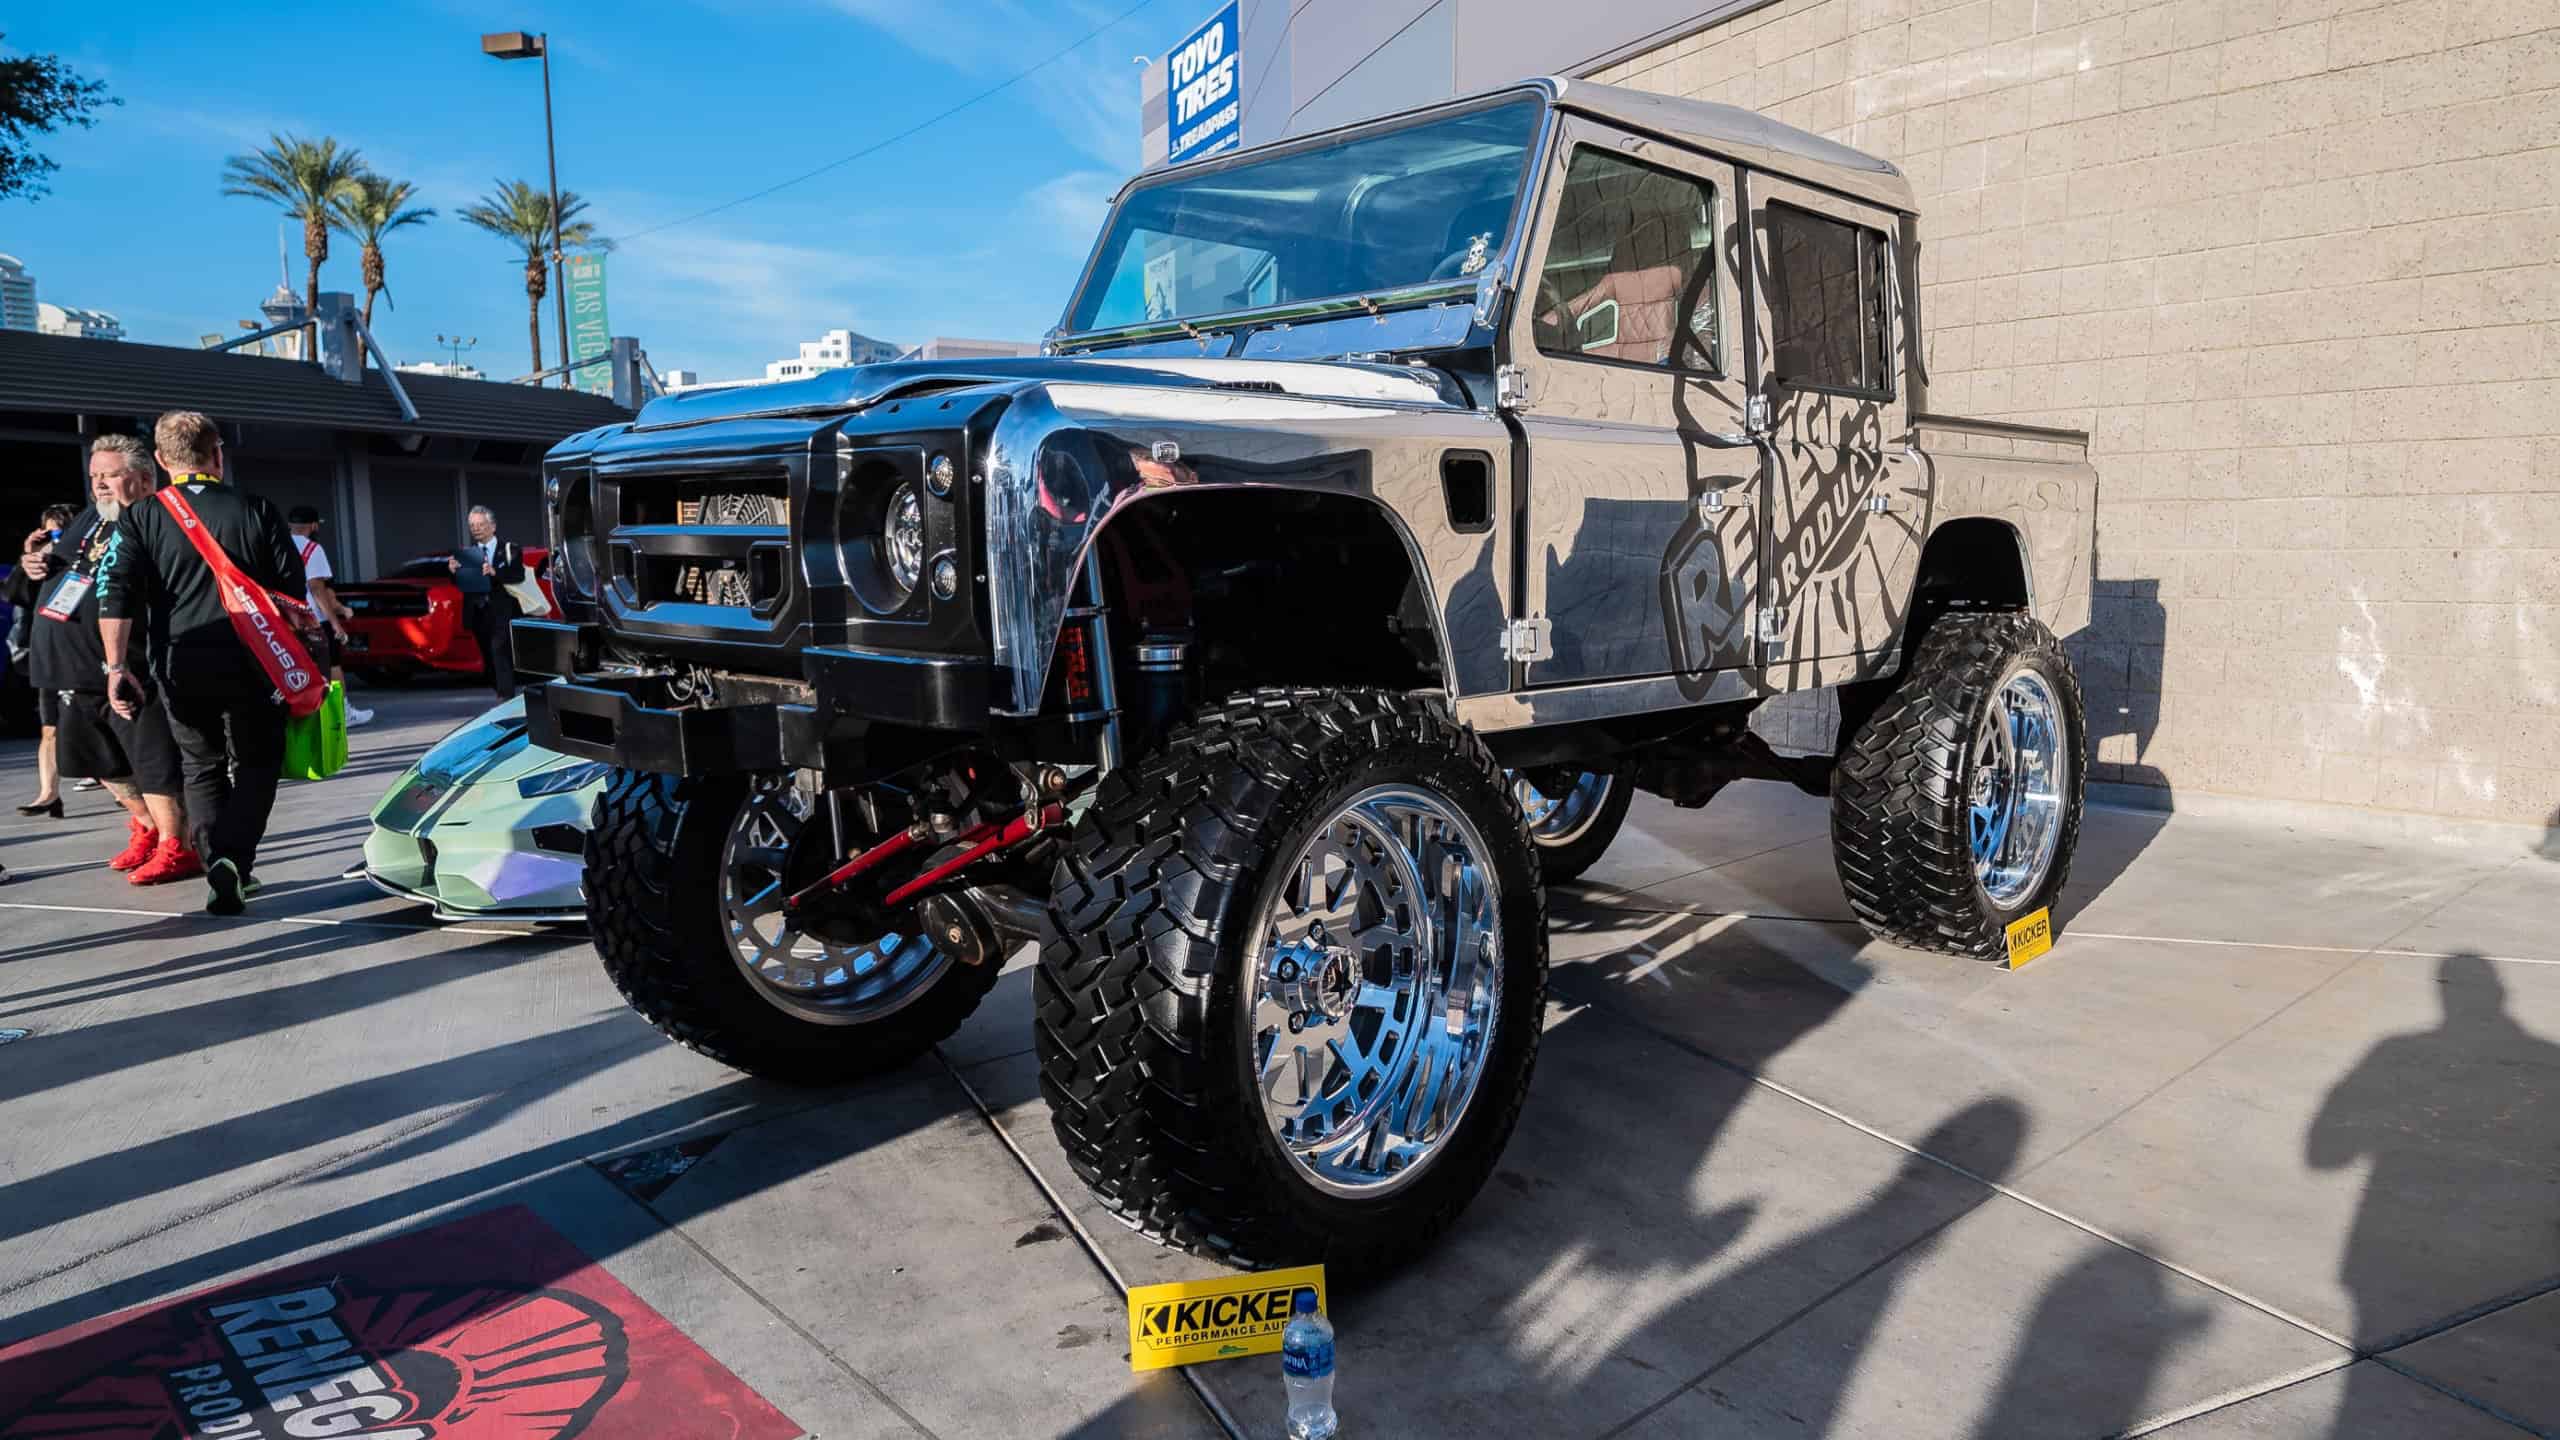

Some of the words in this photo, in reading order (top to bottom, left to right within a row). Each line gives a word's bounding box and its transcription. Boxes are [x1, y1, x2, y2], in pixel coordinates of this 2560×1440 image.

[1171, 21, 1224, 91] TOYO
[1176, 53, 1234, 126] TIRES
[574, 280, 602, 314] LAS
[575, 319, 612, 380] VEGS
[233, 585, 296, 670] SPYDER
[1156, 1325, 1257, 1346] PERFORMANCE
[1263, 1320, 1288, 1332] AU
